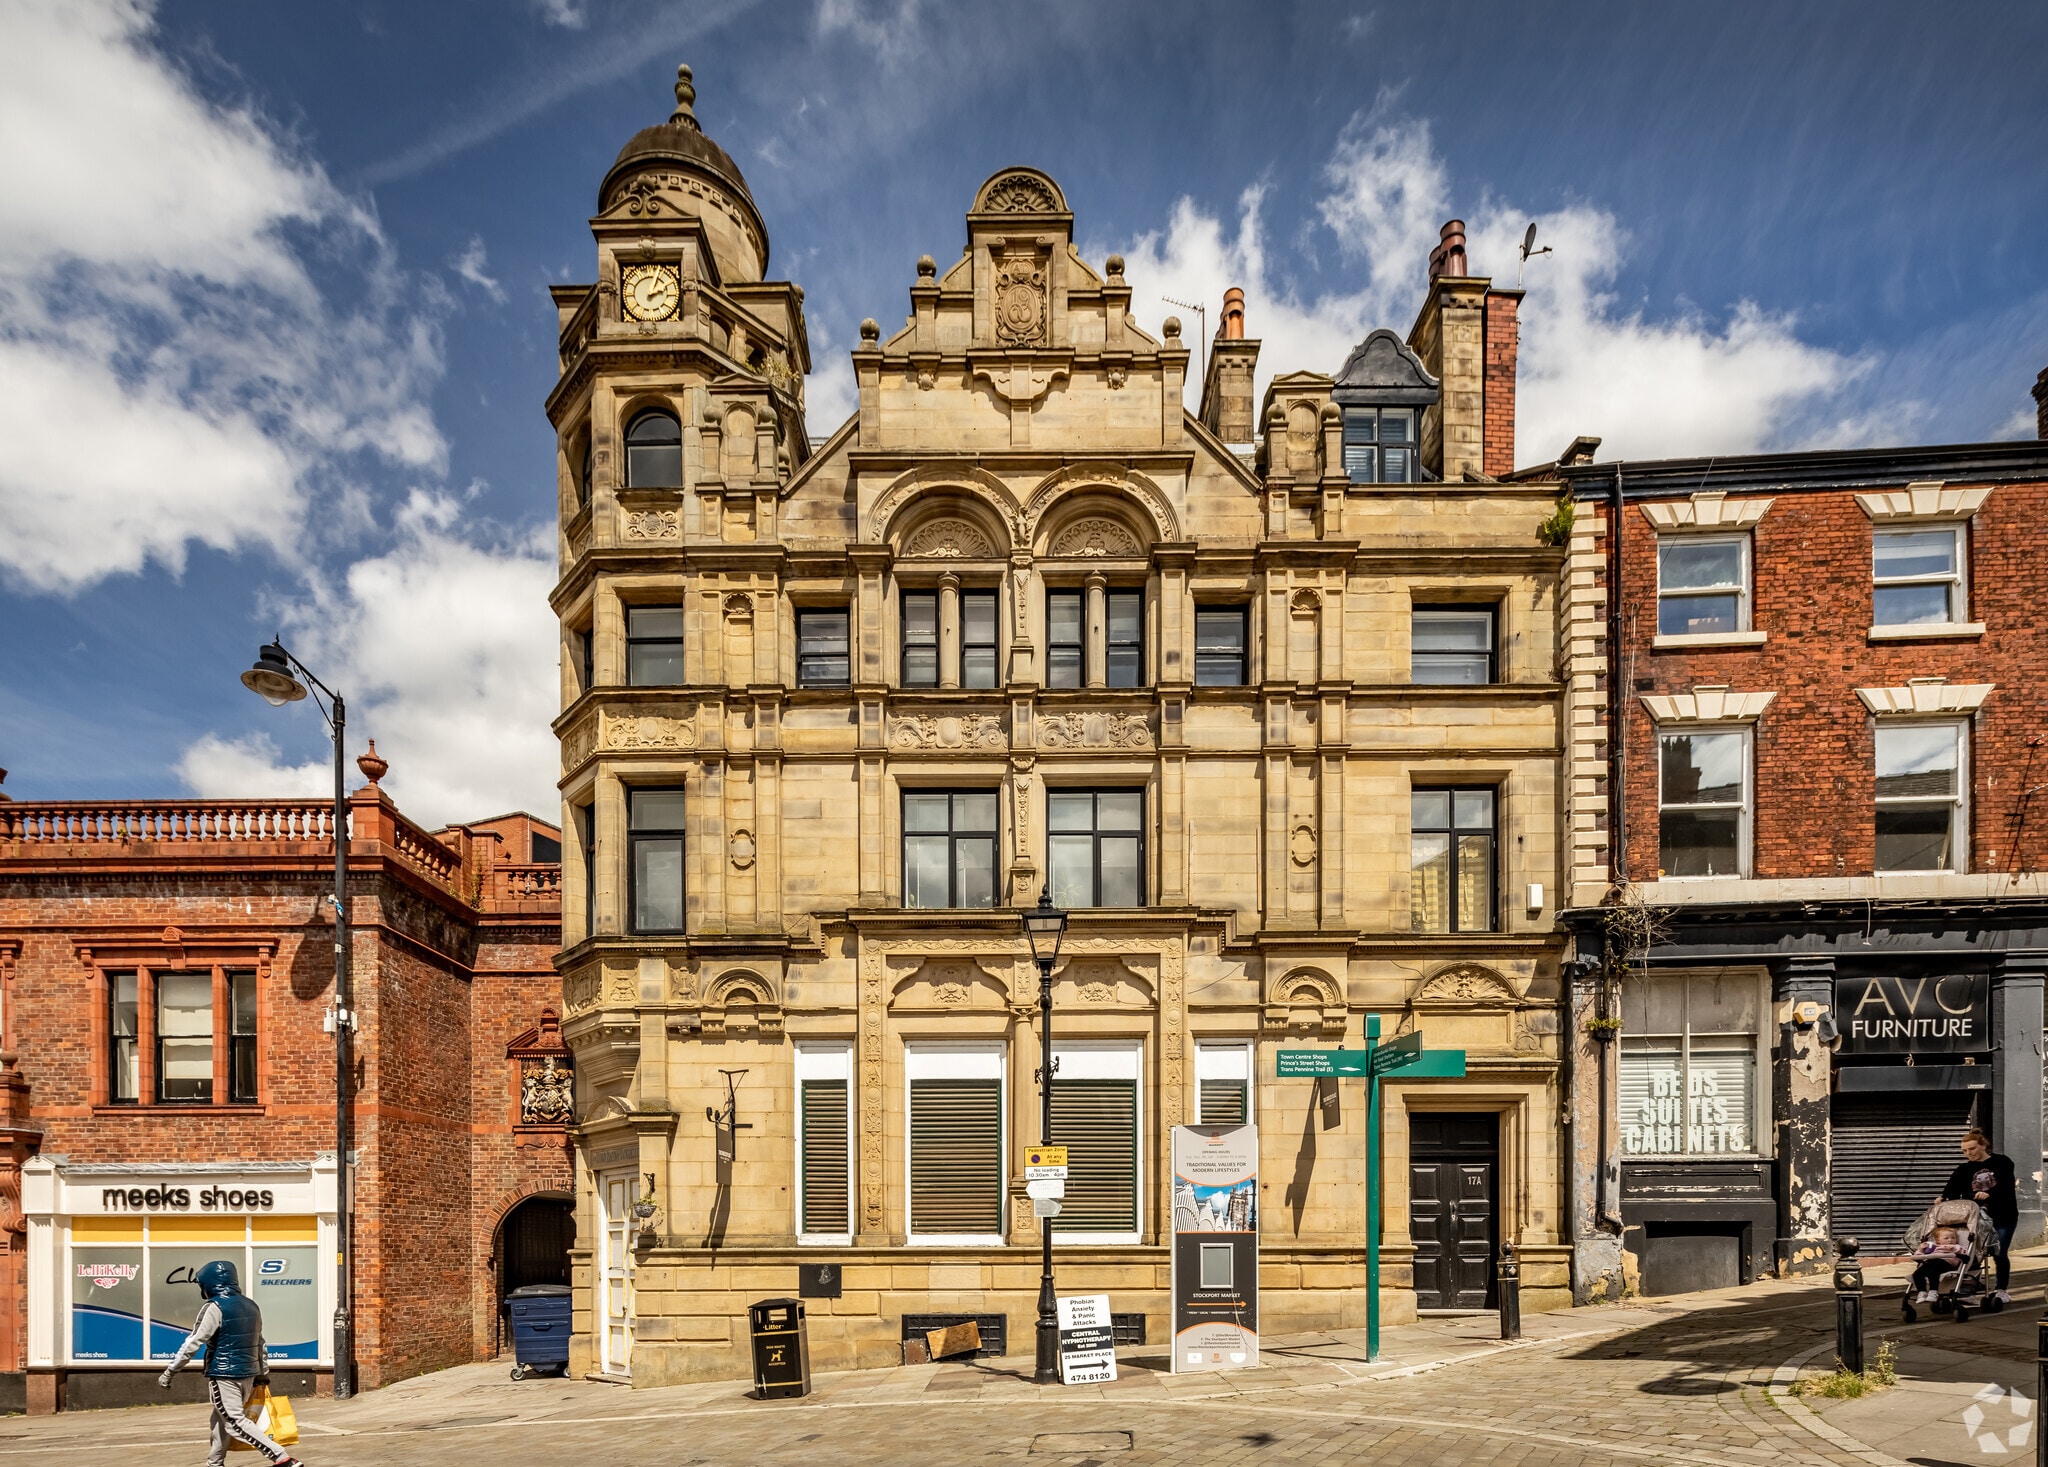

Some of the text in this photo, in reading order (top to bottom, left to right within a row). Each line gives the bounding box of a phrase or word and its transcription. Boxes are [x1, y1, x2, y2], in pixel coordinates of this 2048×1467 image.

[1011, 288, 1030, 305] 19
[1854, 975, 1975, 1016] AVC
[1852, 1018, 1972, 1038] FURNITURE
[1653, 1070, 1718, 1097] BEDS
[1642, 1097, 1728, 1125] SUITES
[1626, 1125, 1745, 1154] CABINETS
[1467, 1176, 1482, 1185] 17A
[103, 1183, 274, 1210] meeks shoes
[764, 1323, 782, 1331] Litter
[1062, 1335, 1112, 1345] HYPNOTHERAPY
[1089, 1372, 1110, 1380] 8120
